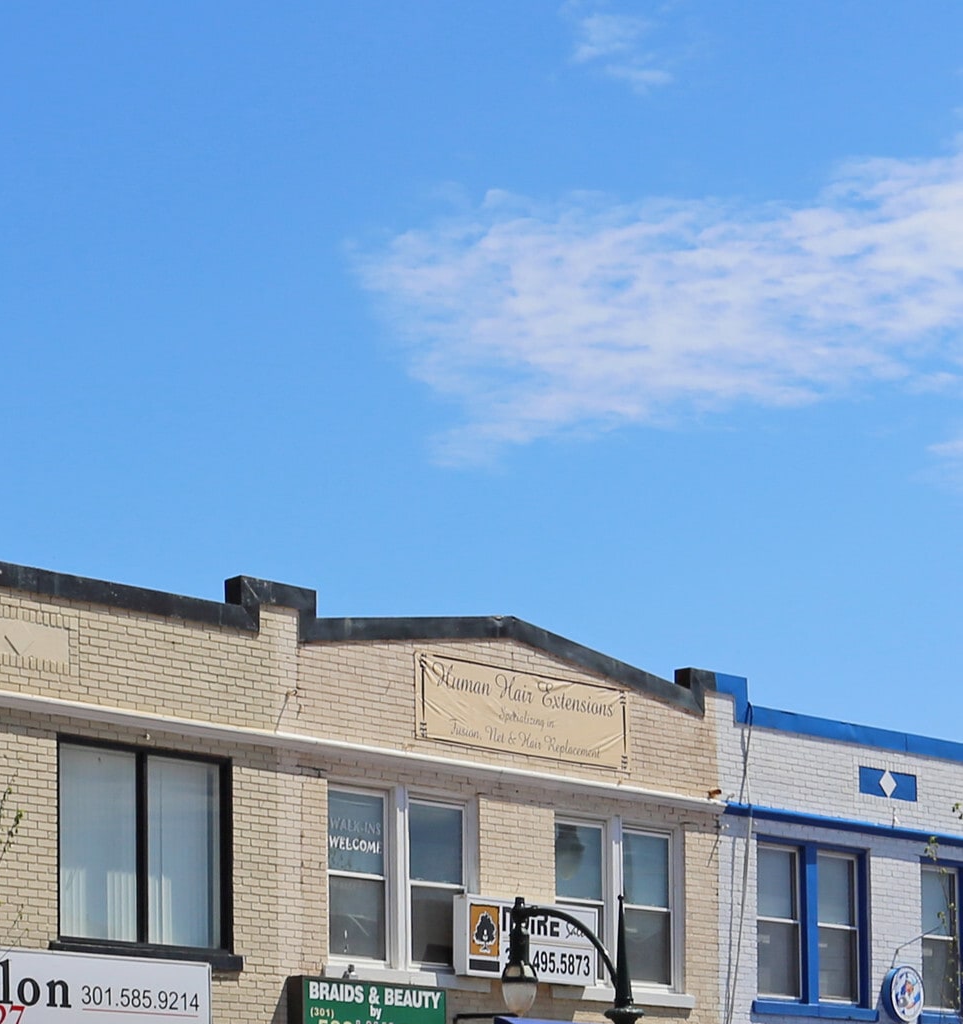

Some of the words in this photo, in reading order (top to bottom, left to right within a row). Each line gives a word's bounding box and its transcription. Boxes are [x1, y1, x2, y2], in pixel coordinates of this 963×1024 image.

[432, 662, 492, 696] Human
[495, 674, 534, 704] Hair
[537, 681, 614, 717] Extensions
[498, 707, 545, 732] Specializing
[485, 726, 505, 744] Net
[508, 733, 517, 745] &
[518, 732, 542, 750] Hair
[544, 736, 600, 758] Replacement
[81, 986, 200, 1012] 301.585.9214
[309, 981, 364, 1004] BRAIDS
[368, 986, 380, 1005] &
[384, 988, 441, 1009] BEAUTY
[310, 1007, 334, 1019] (301)
[369, 1005, 382, 1020] by
